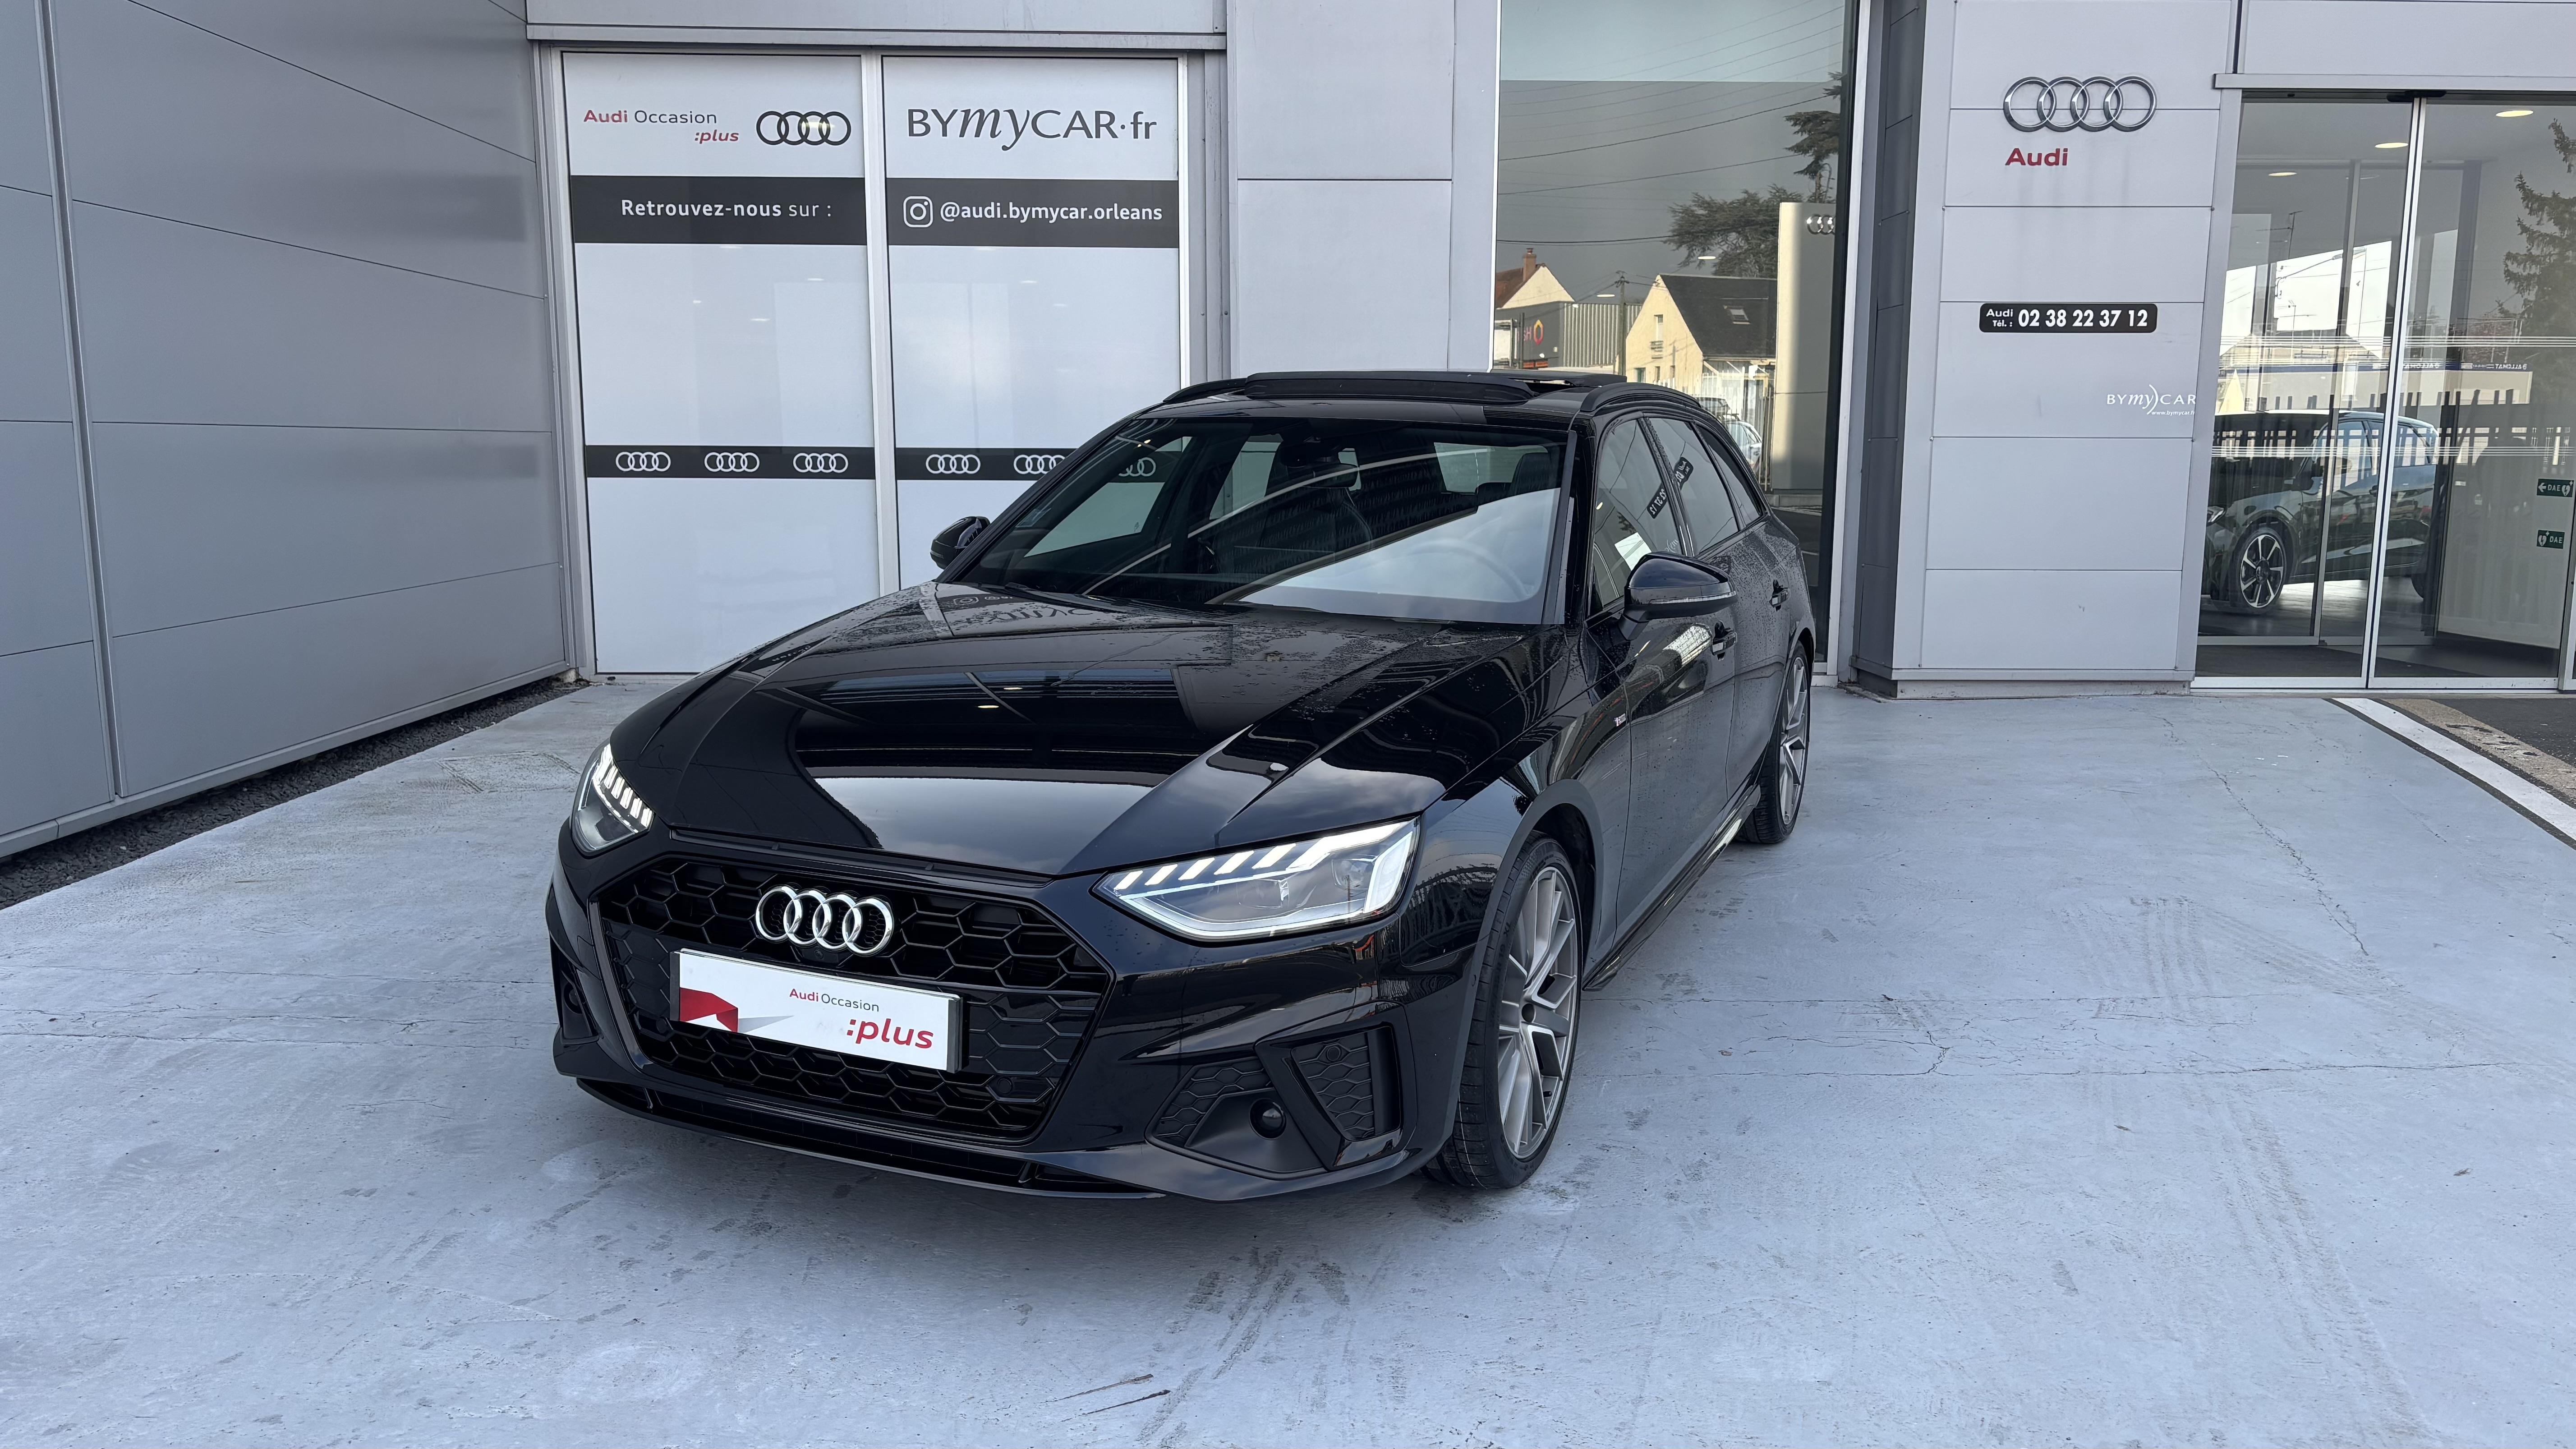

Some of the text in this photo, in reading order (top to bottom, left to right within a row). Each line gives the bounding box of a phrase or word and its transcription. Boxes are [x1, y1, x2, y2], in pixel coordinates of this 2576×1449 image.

[584, 110, 717, 124] Audi Occasion
[694, 129, 739, 144] :plus
[2005, 147, 2068, 166] Audi
[621, 199, 782, 217] Retrouvez-nous
[789, 204, 819, 217] sur
[939, 202, 1163, 224] @audi.bymycar.orleans
[1986, 308, 2148, 327] Audi 02 38 22 37 12
[789, 988, 879, 1012] Audi Occasion
[846, 1018, 934, 1049] :plus
